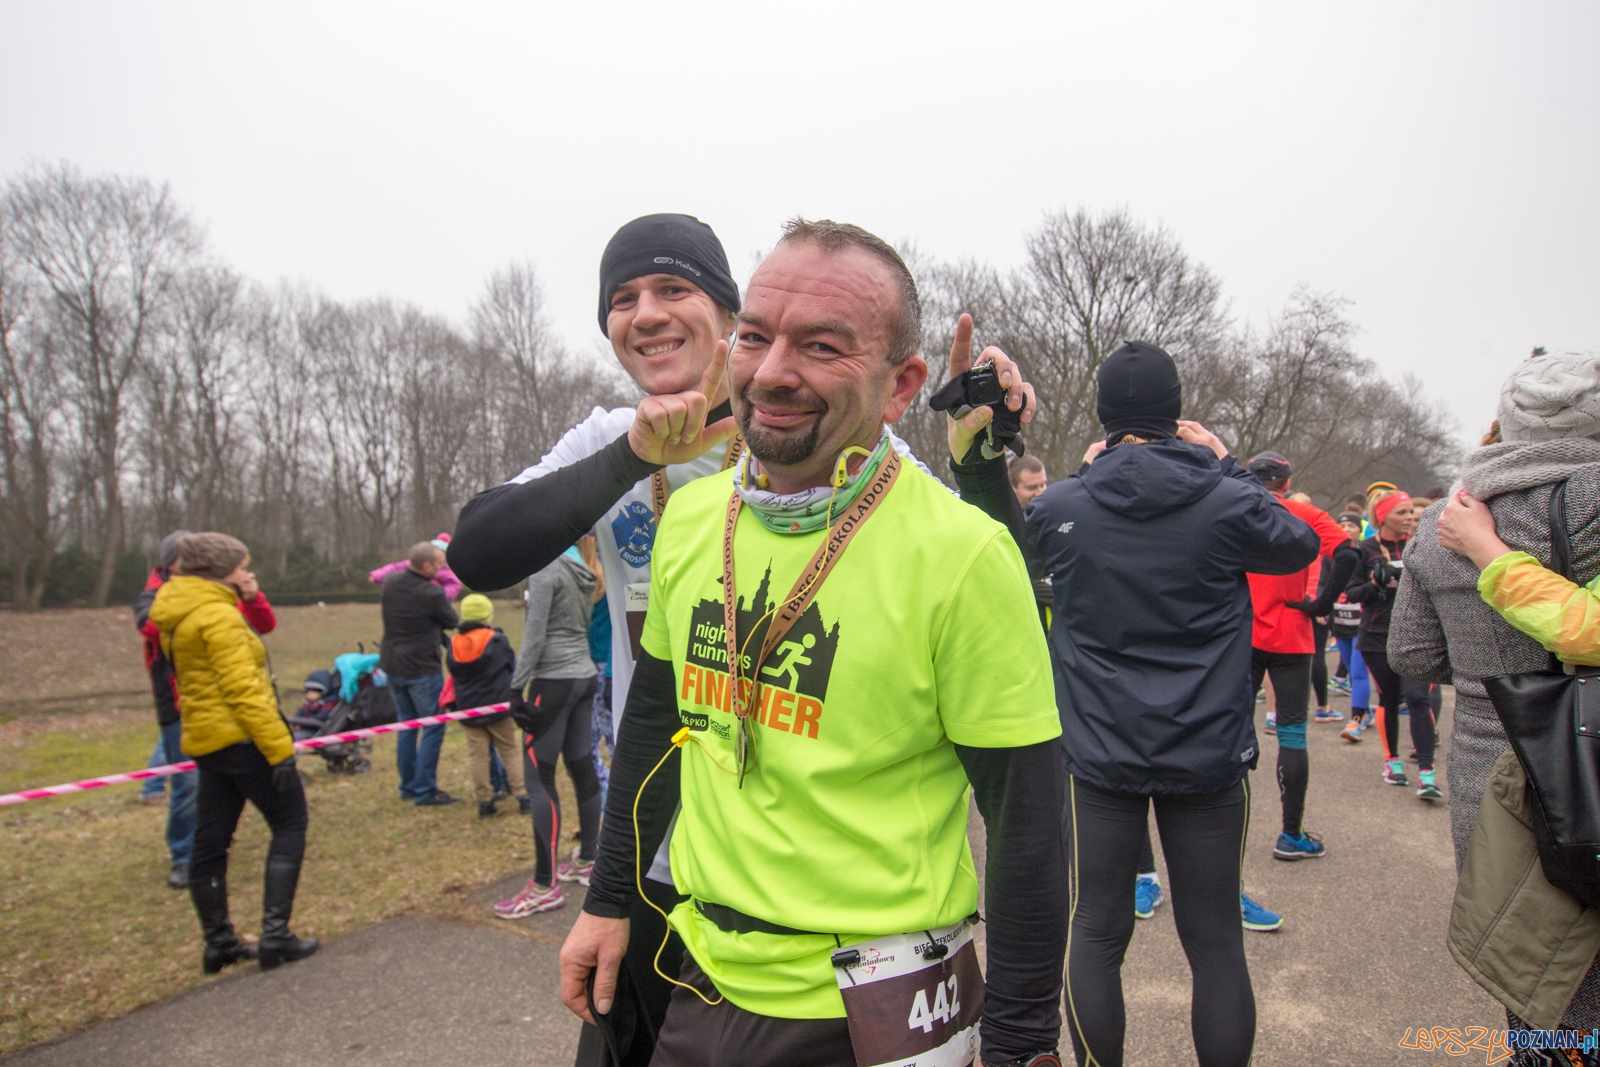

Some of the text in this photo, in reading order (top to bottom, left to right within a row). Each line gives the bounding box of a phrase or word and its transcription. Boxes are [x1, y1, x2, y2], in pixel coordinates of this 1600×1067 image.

[631, 505, 647, 515] OSP
[787, 574, 816, 617] BIEG
[814, 460, 896, 573] CZEKOLADOWY
[1057, 521, 1074, 534] 4F
[622, 551, 650, 563] MOSINA
[695, 621, 728, 644] nigh
[692, 642, 752, 670] runnrs
[681, 663, 823, 740] FINISHER
[848, 955, 895, 970] zekoladowy
[908, 974, 960, 1034] 442
